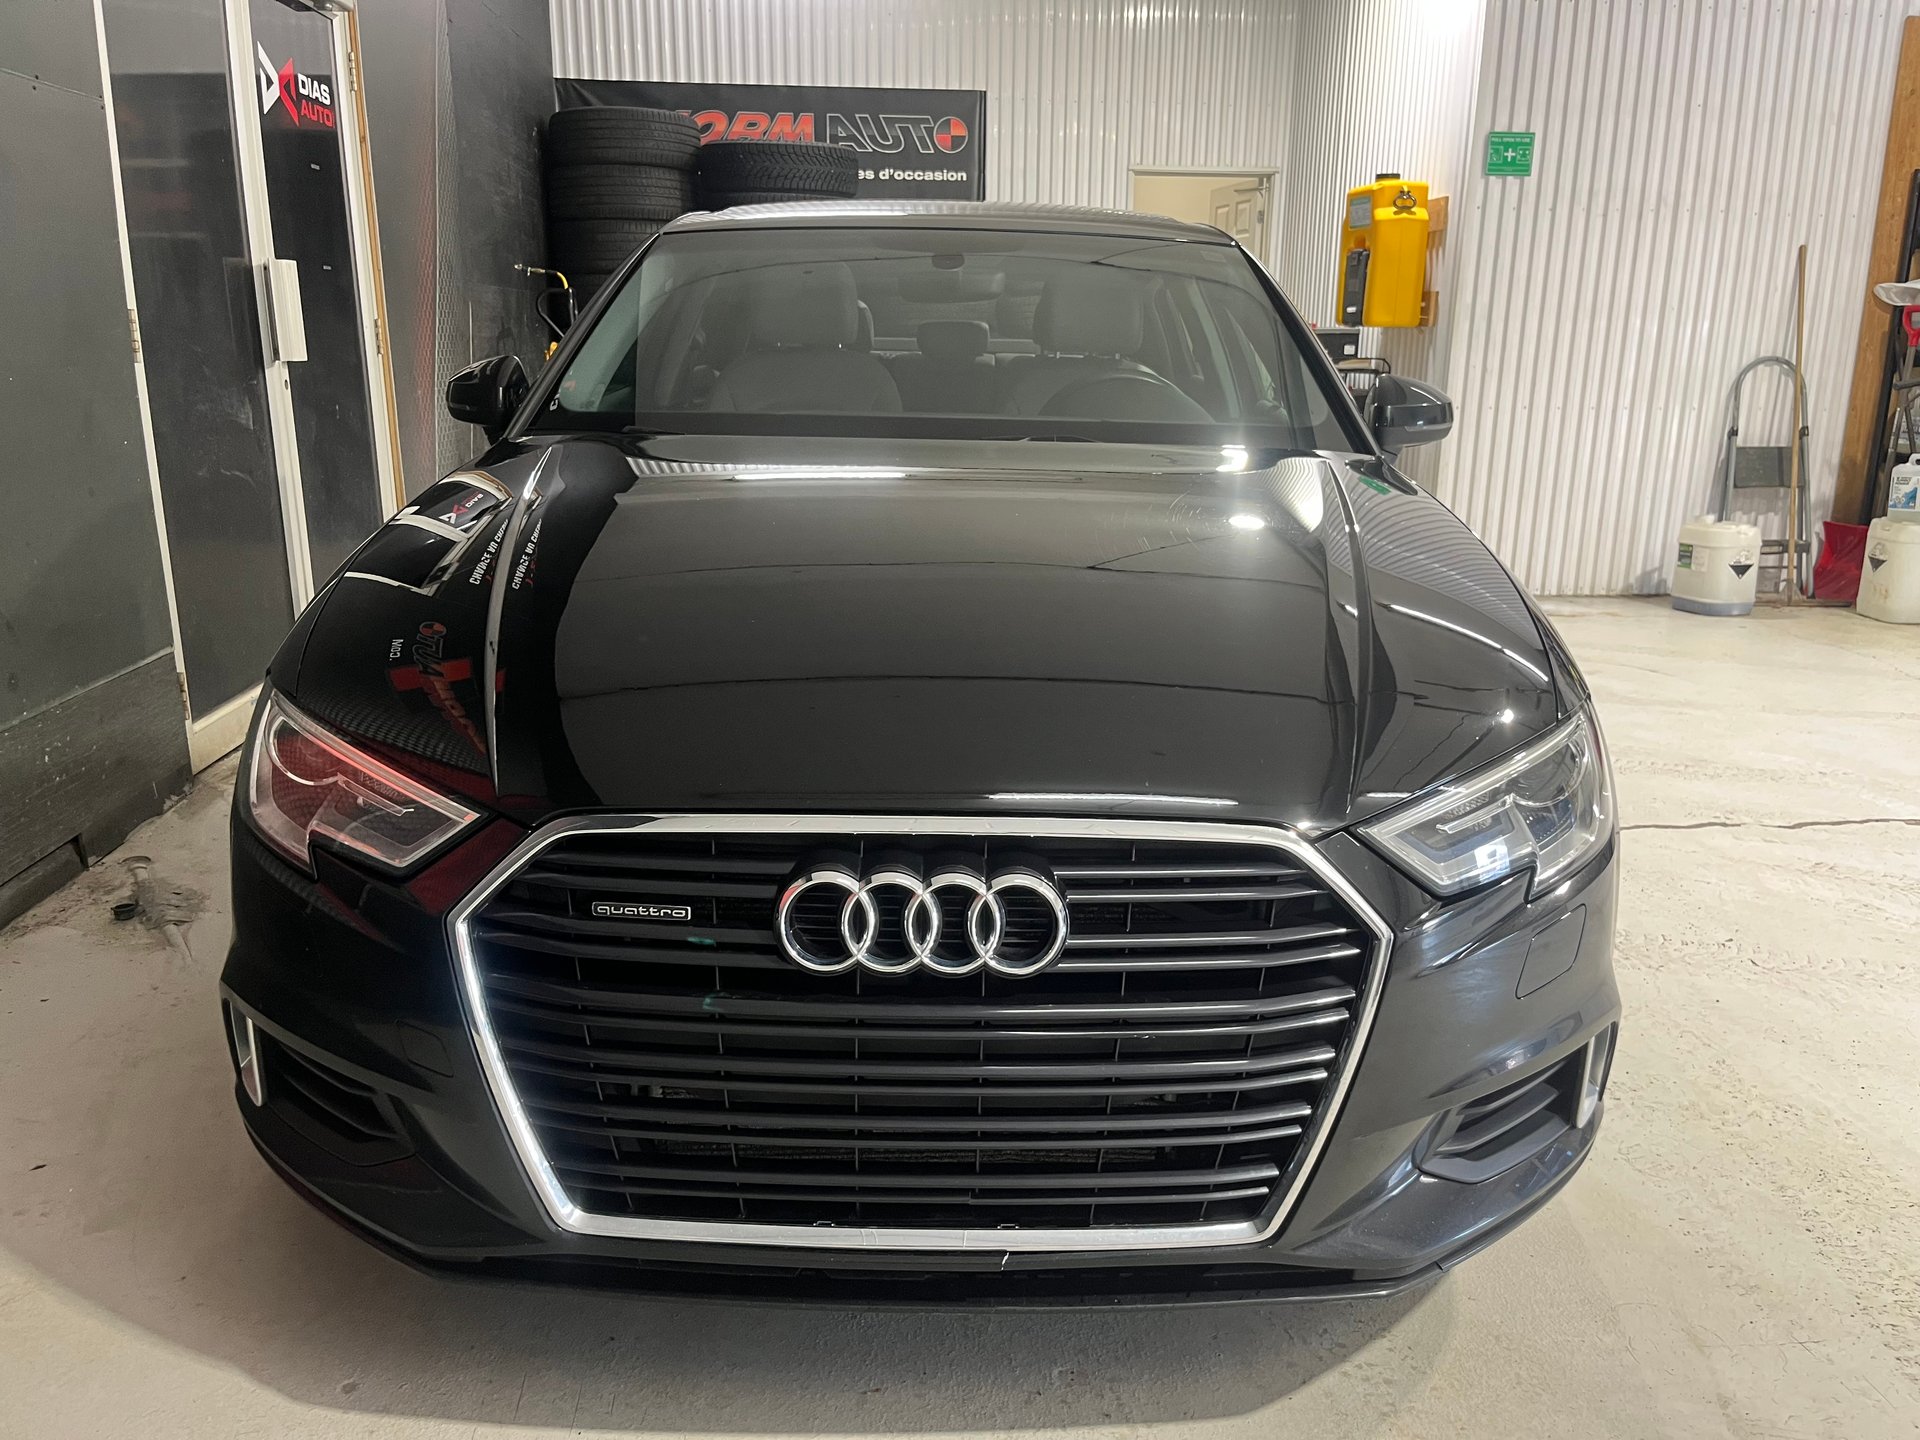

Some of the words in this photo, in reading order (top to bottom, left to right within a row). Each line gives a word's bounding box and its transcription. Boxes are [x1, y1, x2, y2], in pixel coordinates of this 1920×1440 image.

[298, 72, 331, 105] DIAS
[301, 99, 333, 127] AUTO
[675, 109, 815, 146] ORM
[879, 168, 967, 181] d'occasion
[597, 906, 686, 918] quattro
